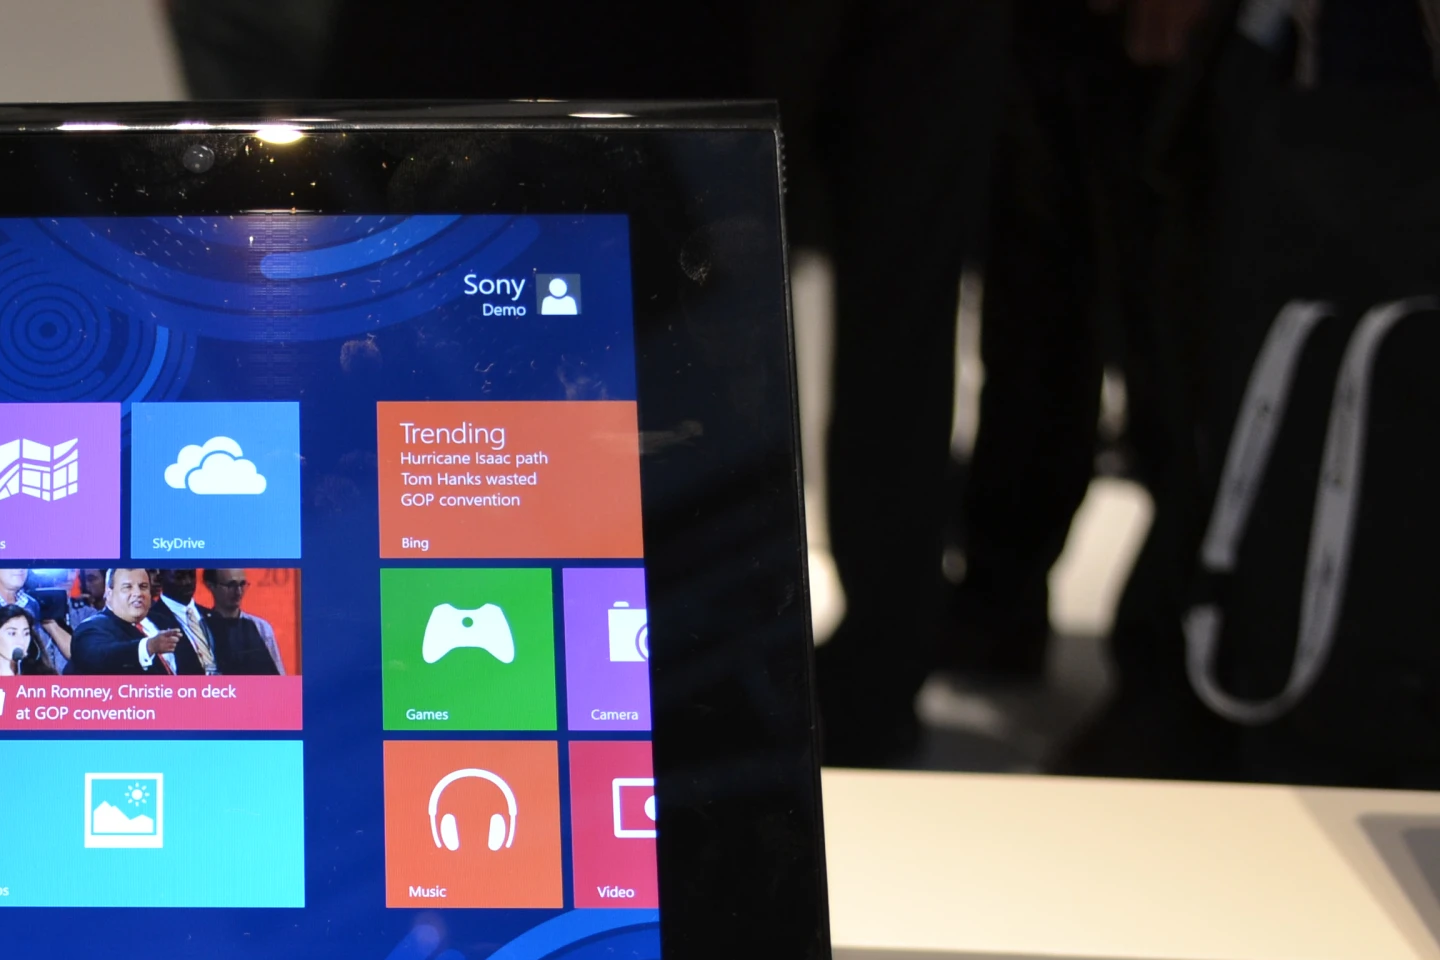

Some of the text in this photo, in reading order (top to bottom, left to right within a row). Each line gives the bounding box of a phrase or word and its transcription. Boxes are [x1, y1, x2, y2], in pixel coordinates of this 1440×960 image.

[463, 274, 526, 300] Sony
[482, 303, 526, 316] Demo
[399, 422, 506, 450] Trending
[400, 452, 549, 469] Hurricane Isaac path
[401, 473, 537, 486] Tom Hanks wasted
[401, 494, 521, 507] GOP convention
[152, 537, 205, 552] SkyDrive
[402, 538, 429, 551] Bing
[16, 684, 237, 702] Ann Romney, Christie on deck
[16, 707, 156, 720] at GOP convention
[405, 709, 449, 721] Games
[590, 709, 638, 721] Camera
[409, 885, 446, 897] Music
[597, 885, 635, 898] Video
